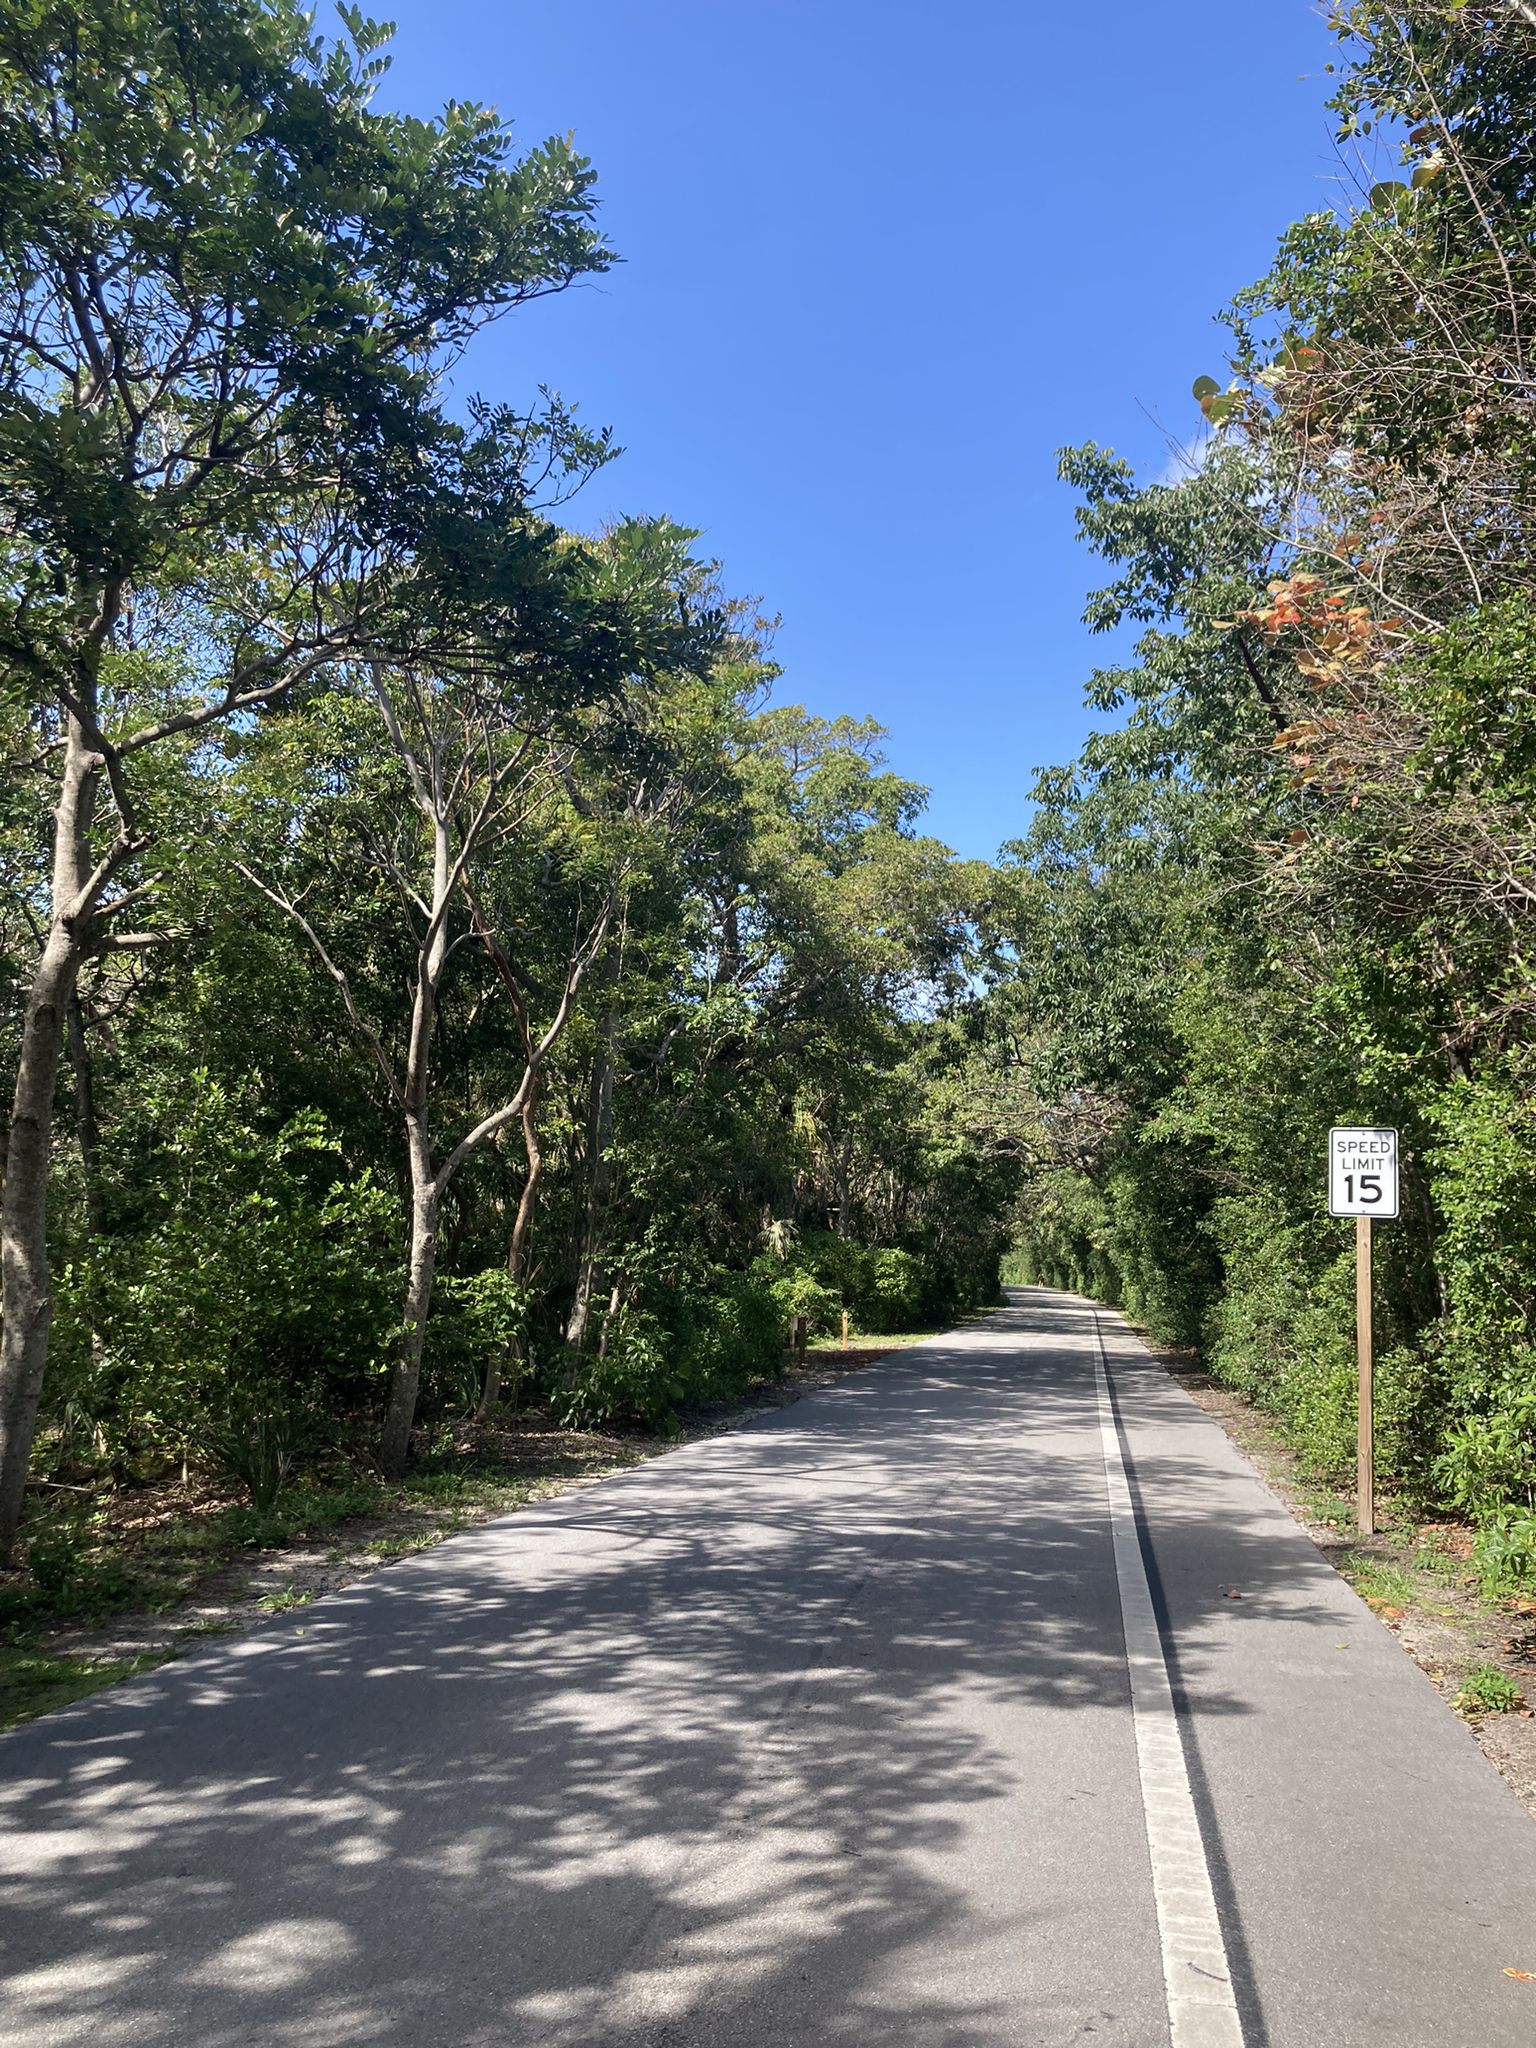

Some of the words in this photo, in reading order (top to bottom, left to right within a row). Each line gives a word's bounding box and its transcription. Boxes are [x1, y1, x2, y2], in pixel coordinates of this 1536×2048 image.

[1337, 1141, 1390, 1153] SPEED
[1342, 1158, 1385, 1170] LIMIT
[1344, 1174, 1382, 1203] 15
